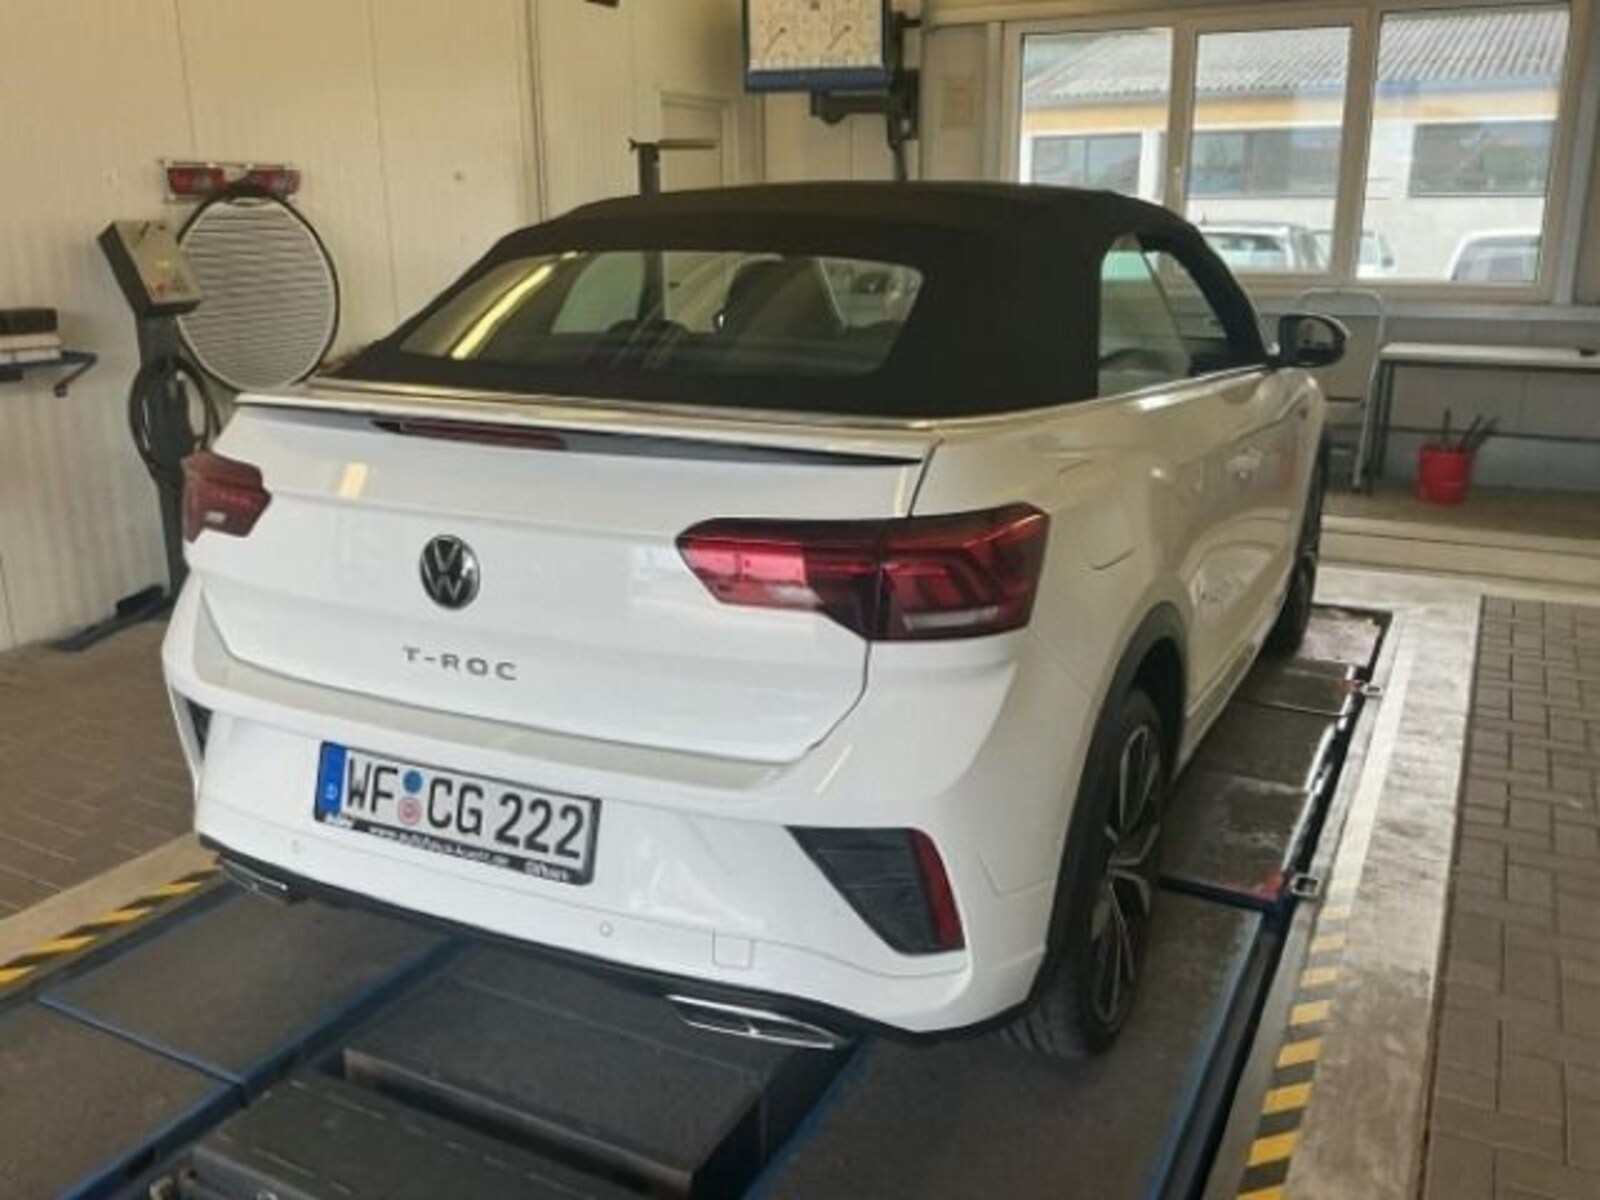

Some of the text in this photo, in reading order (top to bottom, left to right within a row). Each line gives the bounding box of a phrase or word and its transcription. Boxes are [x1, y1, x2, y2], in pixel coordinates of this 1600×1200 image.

[420, 534, 480, 610] VW
[402, 646, 517, 681] T-ROC
[346, 758, 399, 814] WF
[428, 777, 484, 836] CG
[494, 792, 584, 860] 222
